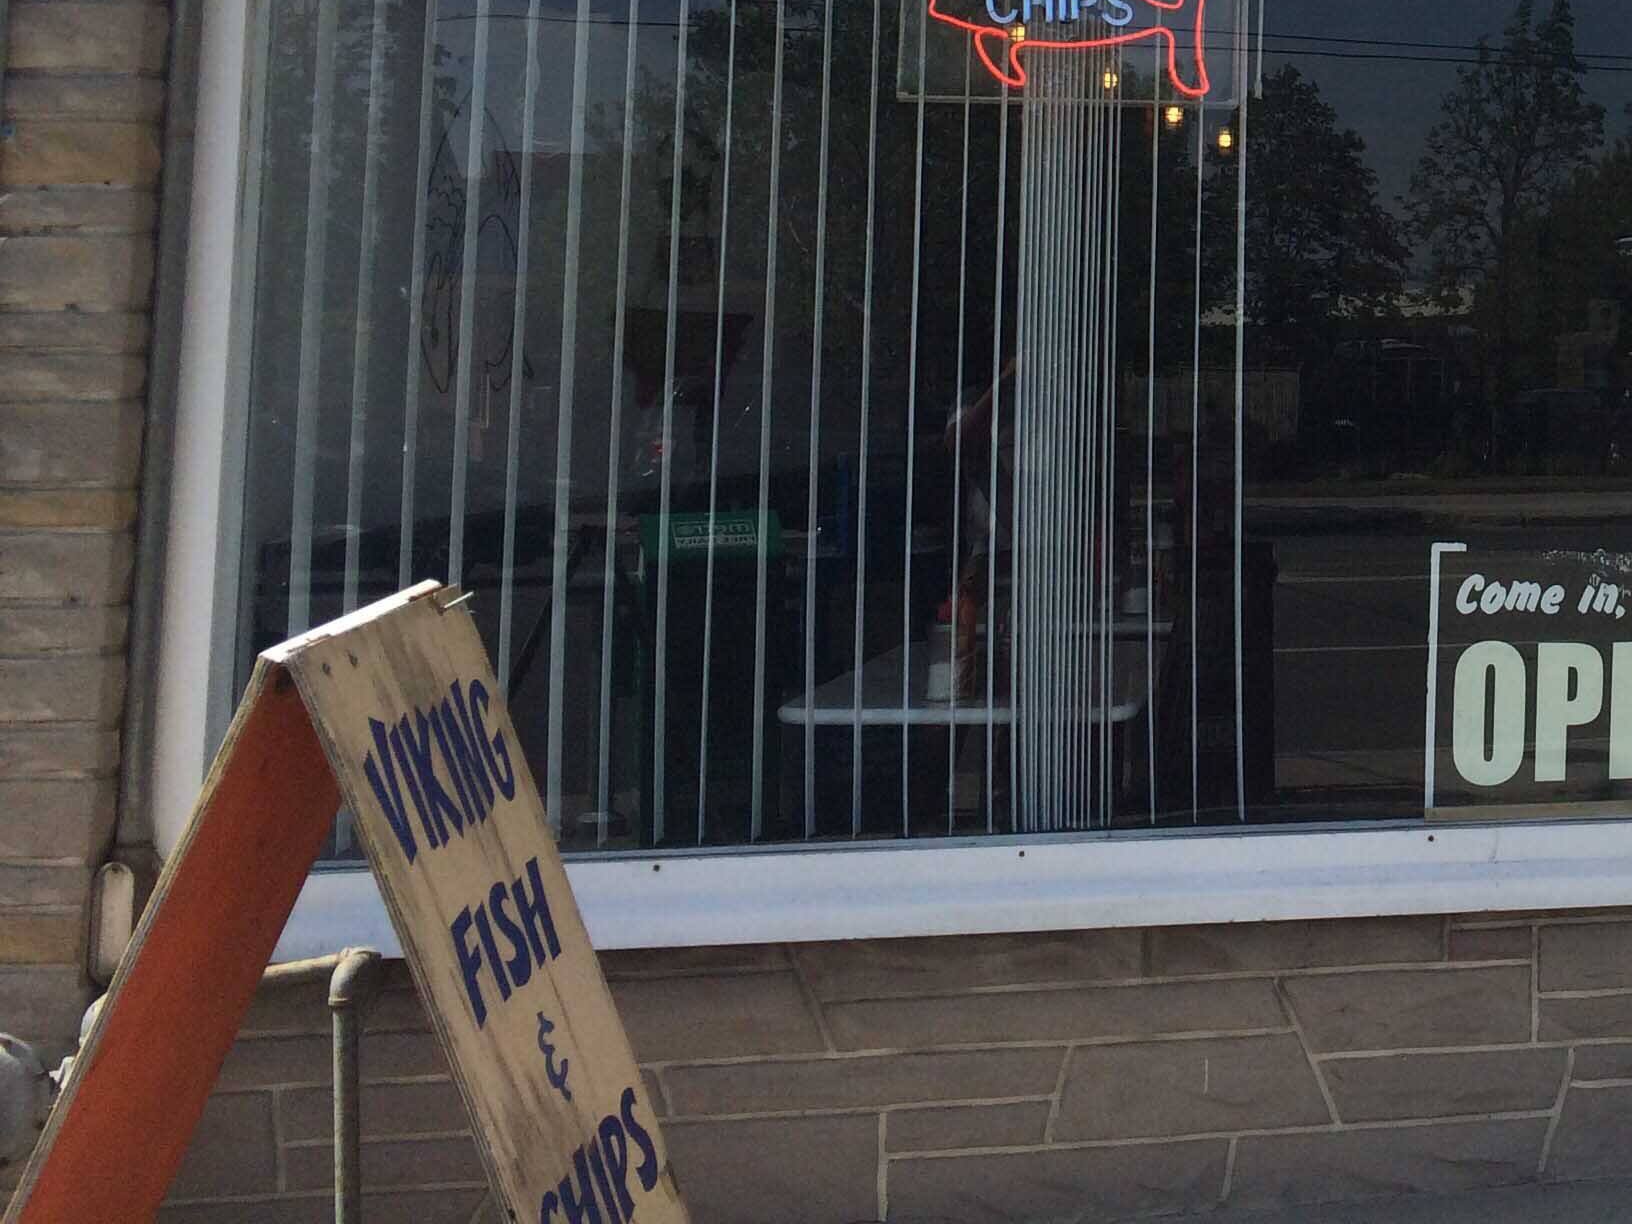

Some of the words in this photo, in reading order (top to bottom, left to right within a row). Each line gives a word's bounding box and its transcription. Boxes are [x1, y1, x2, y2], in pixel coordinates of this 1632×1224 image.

[1455, 574, 1565, 615] Come
[1578, 579, 1626, 620] in,
[362, 678, 516, 866] VIKING
[450, 856, 562, 1031] FISH
